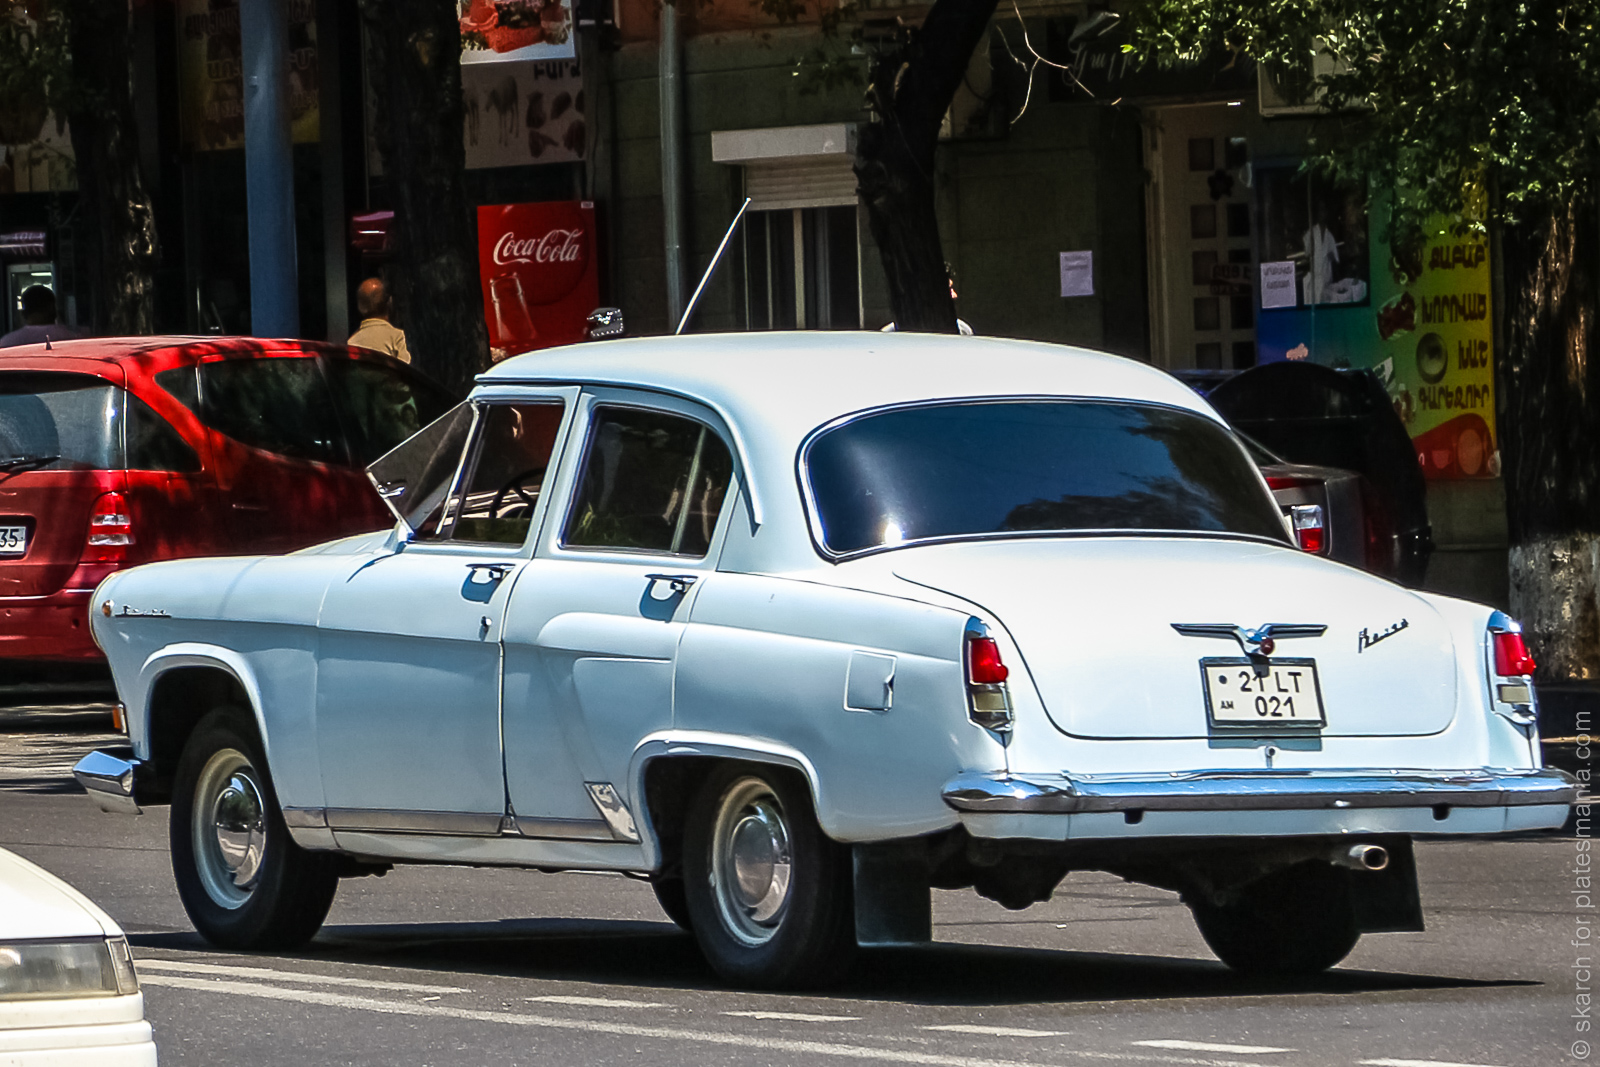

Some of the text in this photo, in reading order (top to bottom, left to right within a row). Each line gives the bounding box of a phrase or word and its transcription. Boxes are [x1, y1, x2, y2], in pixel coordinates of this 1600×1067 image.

[493, 228, 584, 266] Coca-Cola
[1238, 671, 1302, 693] 21 LT
[1219, 700, 1235, 710] AM
[1254, 695, 1296, 717] 021
